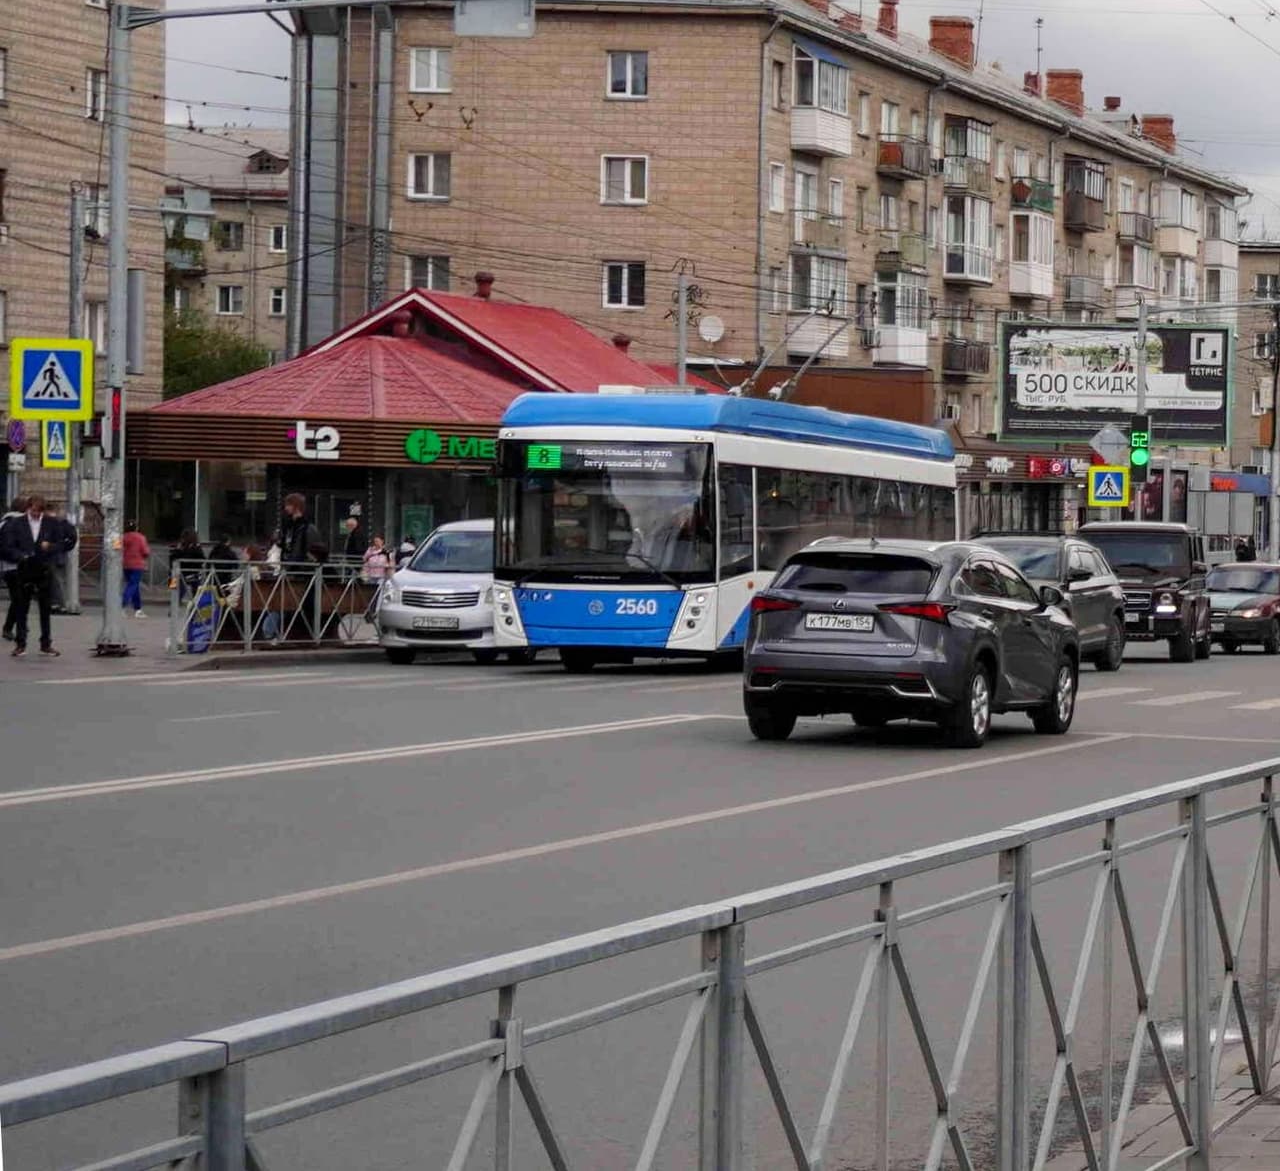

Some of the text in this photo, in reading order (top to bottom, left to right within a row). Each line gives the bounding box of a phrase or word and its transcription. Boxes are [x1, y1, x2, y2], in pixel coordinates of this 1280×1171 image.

[1190, 366, 1223, 376] ТЕТРИС
[1024, 374, 1067, 394] 500
[287, 421, 340, 460] t2
[1131, 433, 1148, 447] 62
[615, 598, 657, 615] 2560
[854, 615, 871, 626] 154
